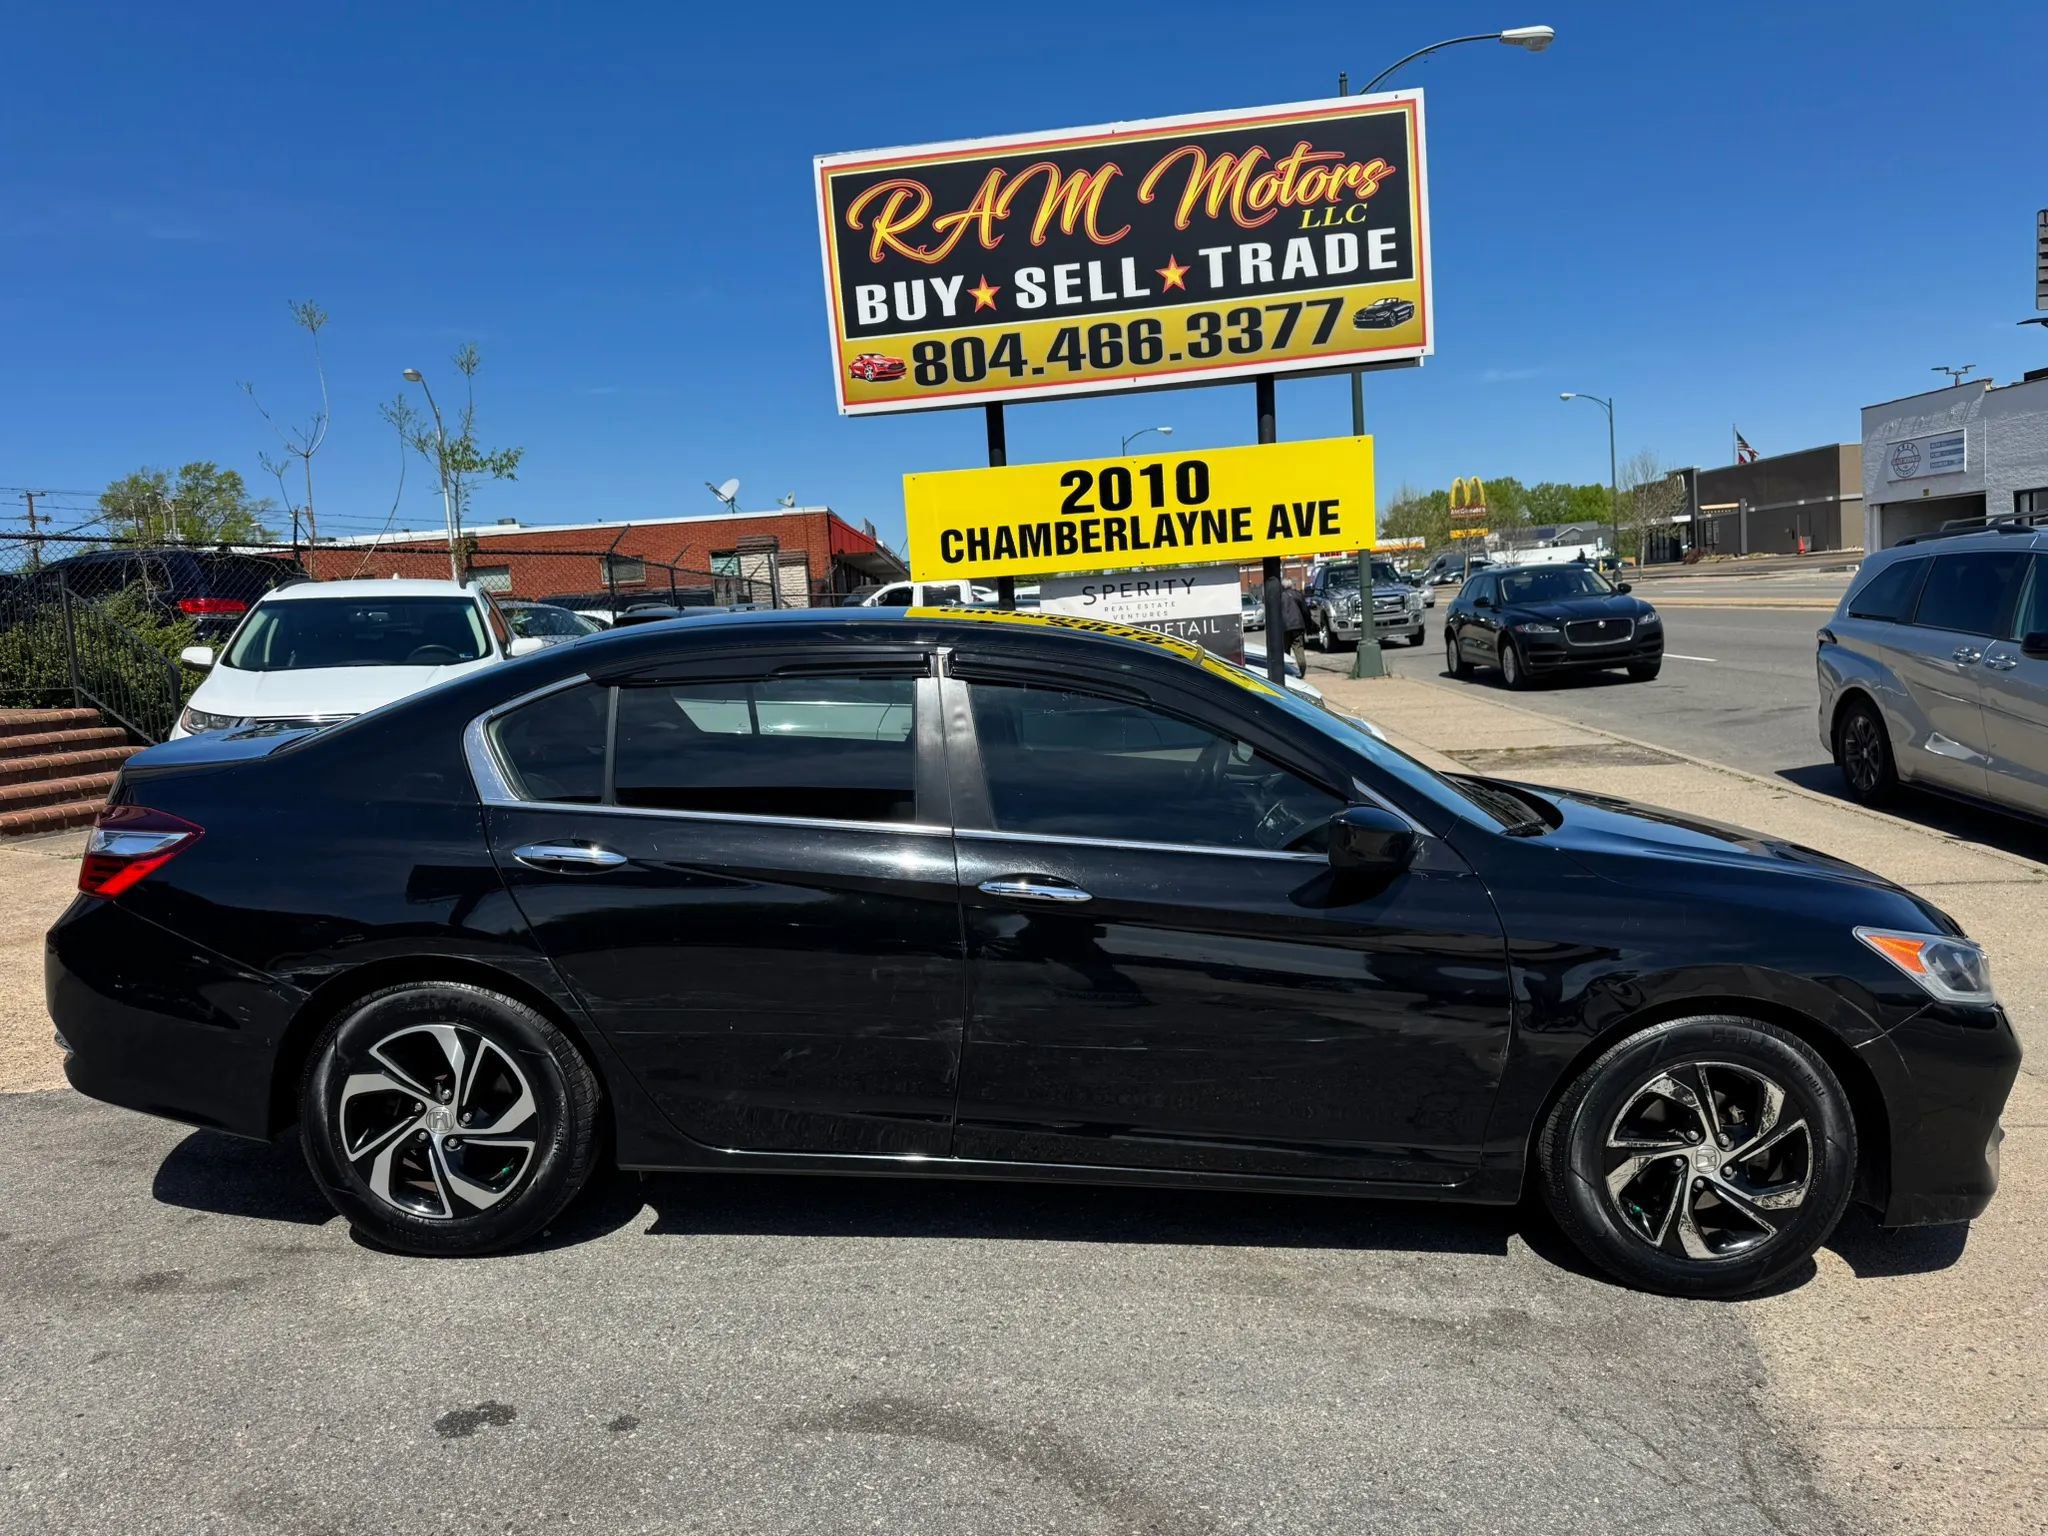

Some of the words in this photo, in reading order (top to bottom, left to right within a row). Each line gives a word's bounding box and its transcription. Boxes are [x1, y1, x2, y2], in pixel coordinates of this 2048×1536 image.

[845, 162, 1131, 264] RAM
[1137, 140, 1396, 230] Motors
[1297, 203, 1368, 230] LLC
[855, 275, 964, 326] BUY
[1015, 257, 1150, 309] SELL
[1199, 227, 1397, 288] TRADE
[913, 296, 1344, 387] 804.466.3377
[1060, 460, 1210, 515] 2010
[940, 506, 1252, 564] CHAMBERLAYNE
[1267, 499, 1341, 541] AVE
[1082, 577, 1196, 606] SPERITY
[1104, 604, 1130, 613] REAL
[1137, 601, 1176, 610] ESTATE
[1112, 610, 1169, 621] VENTURES
